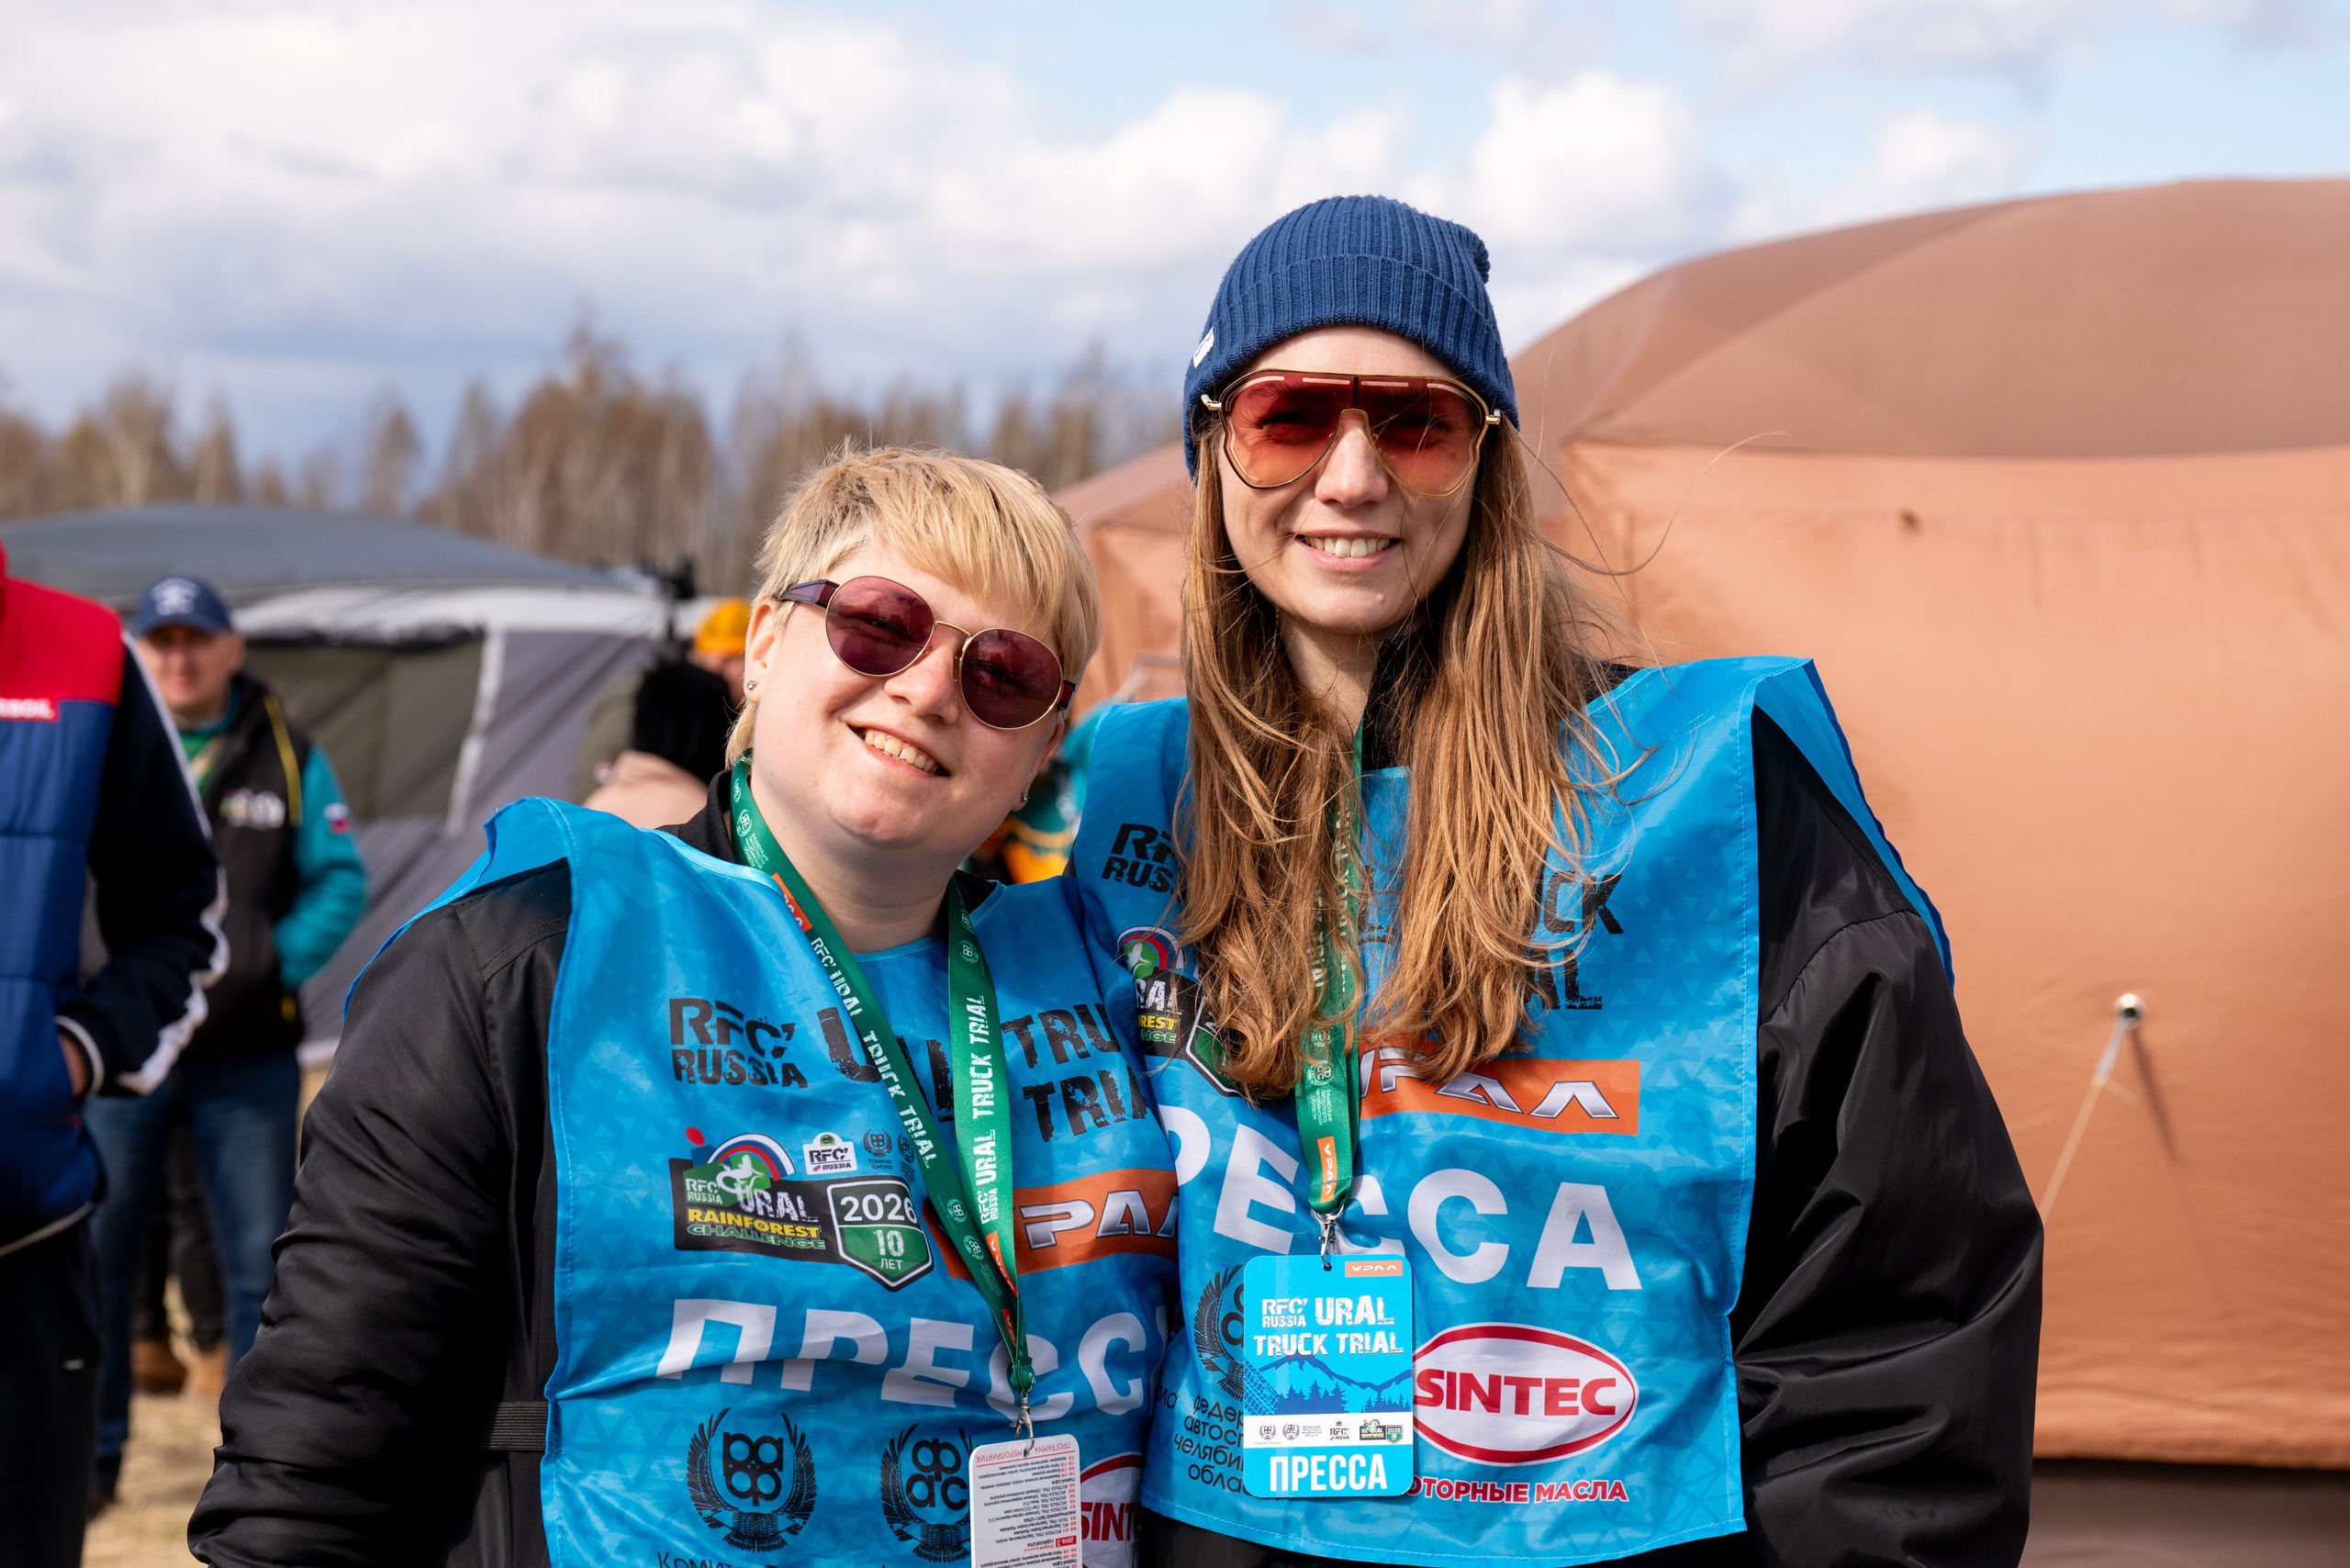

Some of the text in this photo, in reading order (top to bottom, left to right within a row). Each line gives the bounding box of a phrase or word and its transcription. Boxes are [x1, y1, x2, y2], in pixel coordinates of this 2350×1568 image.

[1111, 823, 1176, 863] RF
[1102, 857, 1173, 893] RUS
[1001, 1003, 1121, 1070] TRU
[671, 1048, 809, 1089] RUSSIA
[966, 995, 997, 1186] URAL TRUCK TRIAL
[1023, 1065, 1147, 1143] TRI
[899, 1104, 939, 1170] TRIAL
[822, 1161, 852, 1170] RUSSIA
[1324, 1142, 1333, 1196] УРАЛ
[687, 1191, 723, 1204] RUSSIA
[738, 1188, 820, 1223] URAL
[840, 1193, 917, 1223] 2026
[989, 1188, 999, 1221] RUSSIA
[1159, 1104, 1643, 1290] РЕССА
[688, 1208, 820, 1239] RAINFOREST
[688, 1225, 826, 1250] CHALLENGE
[873, 1229, 904, 1257] 10
[880, 1258, 903, 1271] ЛЕТ
[1350, 1263, 1398, 1272] УРАЛ
[1262, 1315, 1307, 1328] RUSSIA
[1315, 1295, 1394, 1326] URAL
[655, 1298, 1147, 1422] ПРЕСС
[1253, 1331, 1404, 1357] TRUCK TRIAL
[1414, 1369, 1617, 1417] SINTEC
[1193, 1394, 1244, 1430] федер
[976, 1449, 1024, 1463] МЕРОПРИЯТИЯ
[1035, 1441, 1071, 1454] ПРОГРАММА
[1173, 1433, 1244, 1473] челяби
[1188, 1463, 1252, 1497] обла
[1270, 1453, 1388, 1492] ПРЕССА
[1406, 1476, 1629, 1503] ОТОРНЫЕ МАСЛА
